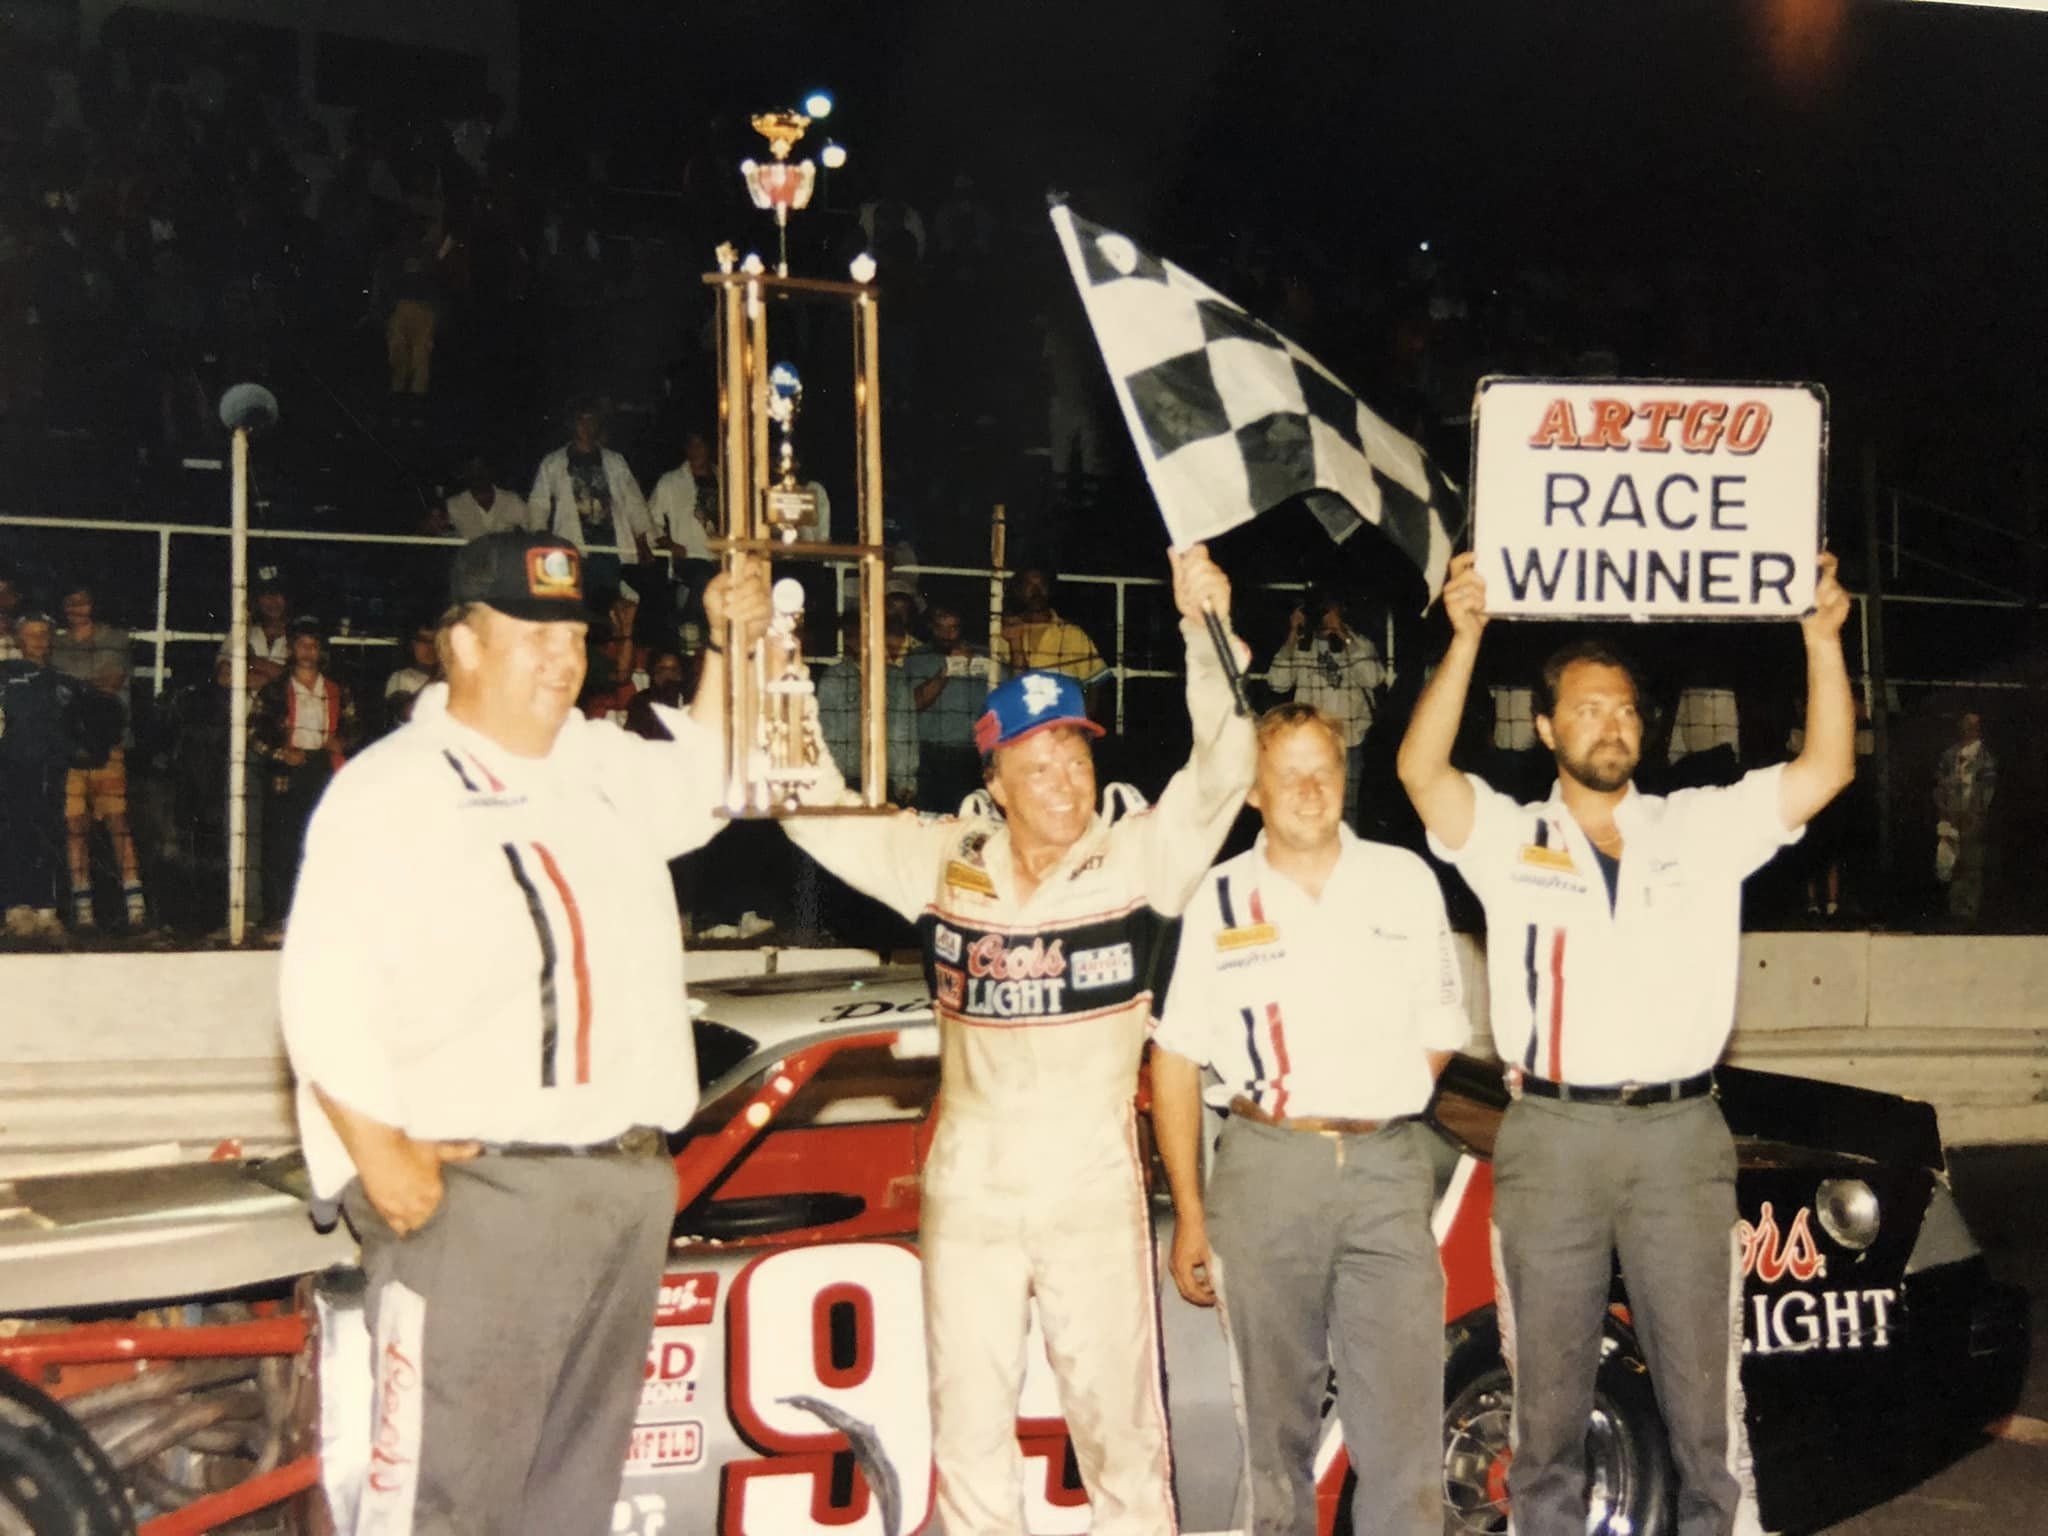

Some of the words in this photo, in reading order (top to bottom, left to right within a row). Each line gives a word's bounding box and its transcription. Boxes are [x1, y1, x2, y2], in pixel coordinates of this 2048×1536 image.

[1528, 399, 1773, 455] ARTGO
[1543, 473, 1748, 531] RACE
[1501, 548, 1797, 605] WINNER
[966, 934, 1067, 979] Coors
[966, 977, 1066, 1015] LIGHT
[1731, 1201, 1820, 1283] ors
[1741, 1288, 1896, 1354] IGHT
